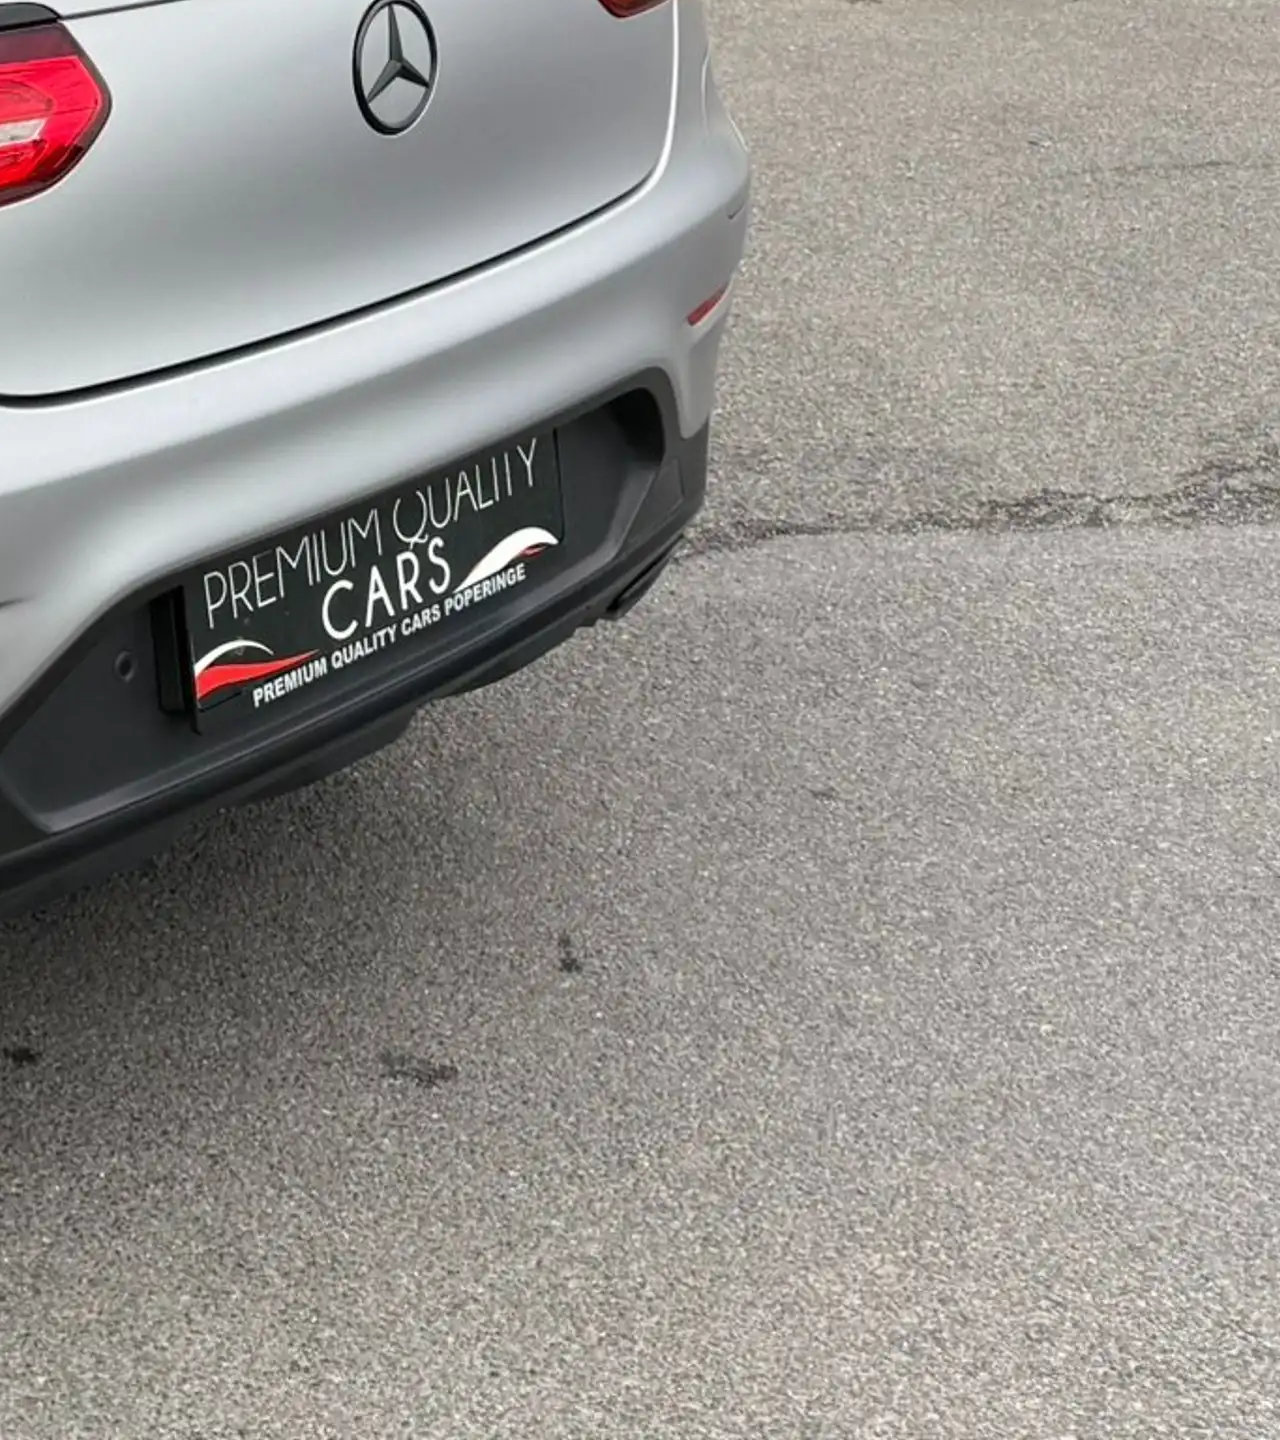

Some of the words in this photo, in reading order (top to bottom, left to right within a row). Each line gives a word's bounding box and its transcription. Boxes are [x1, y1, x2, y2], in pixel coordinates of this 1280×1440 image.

[203, 508, 383, 629] PREMIUM
[321, 536, 451, 640] CARS
[252, 658, 328, 708] PREMIUM
[331, 624, 397, 669] QUALITY
[401, 605, 441, 636] CARS
[444, 563, 527, 616] POPERINGE
